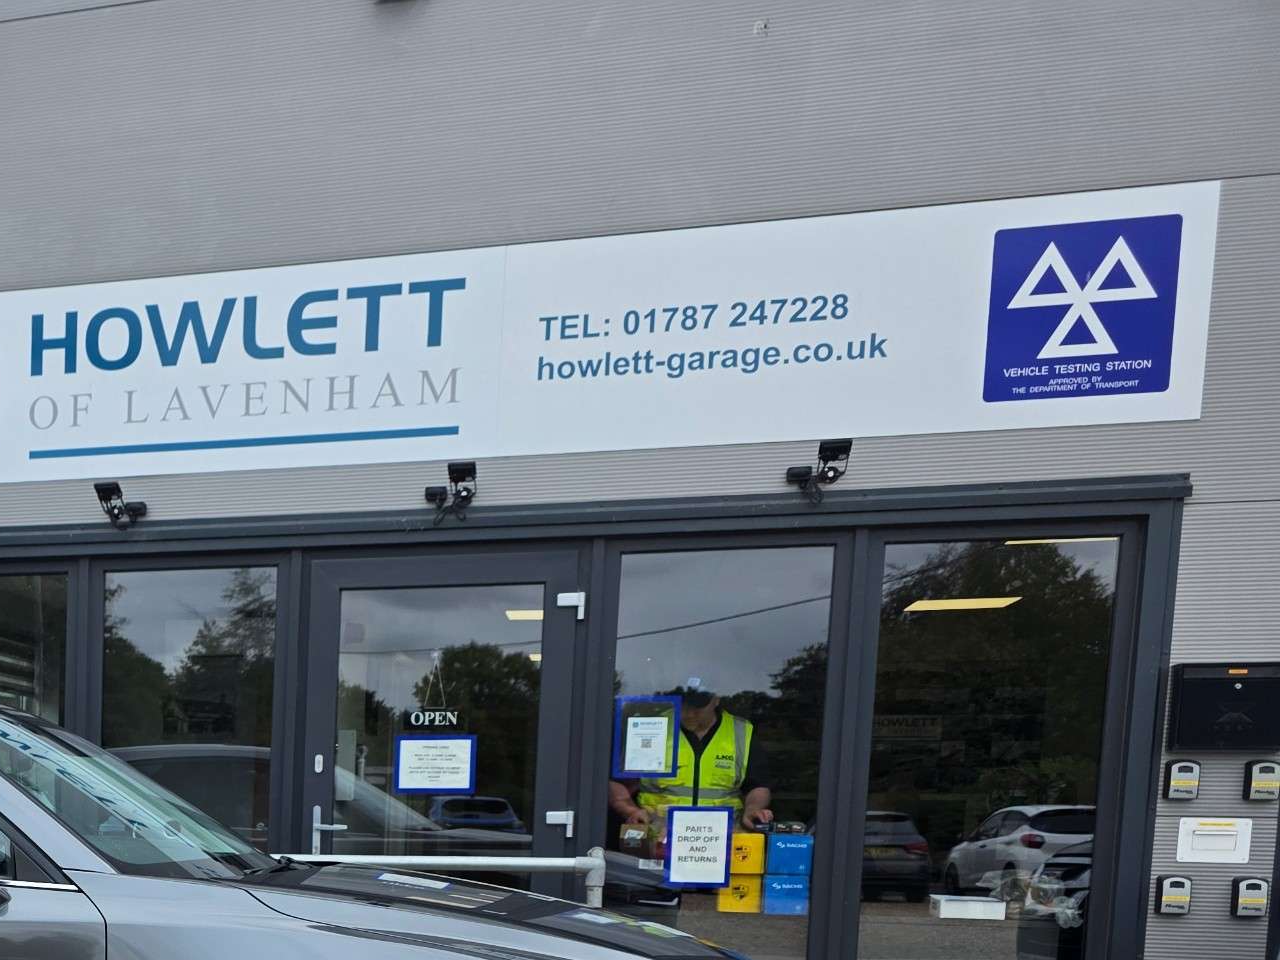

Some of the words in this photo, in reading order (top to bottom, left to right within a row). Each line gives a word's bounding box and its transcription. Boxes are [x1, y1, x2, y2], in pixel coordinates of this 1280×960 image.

[30, 277, 467, 377] HOWLETT
[539, 314, 610, 341] TEL:
[623, 304, 718, 335] 01787
[729, 293, 849, 327] 247228
[537, 333, 888, 380] howlett-garage.co.uk
[1003, 365, 1049, 378] VEHICLE
[1054, 362, 1101, 374] TESTING
[1105, 359, 1152, 371] STATION
[1029, 384, 1078, 394] DEPARTMENT
[1095, 380, 1139, 390] TRANSPORT
[1048, 376, 1089, 385] APPROVED
[1091, 375, 1103, 383] BY
[28, 393, 94, 430] OF
[123, 367, 463, 425] LAVENHAM
[410, 711, 458, 725] OPEN
